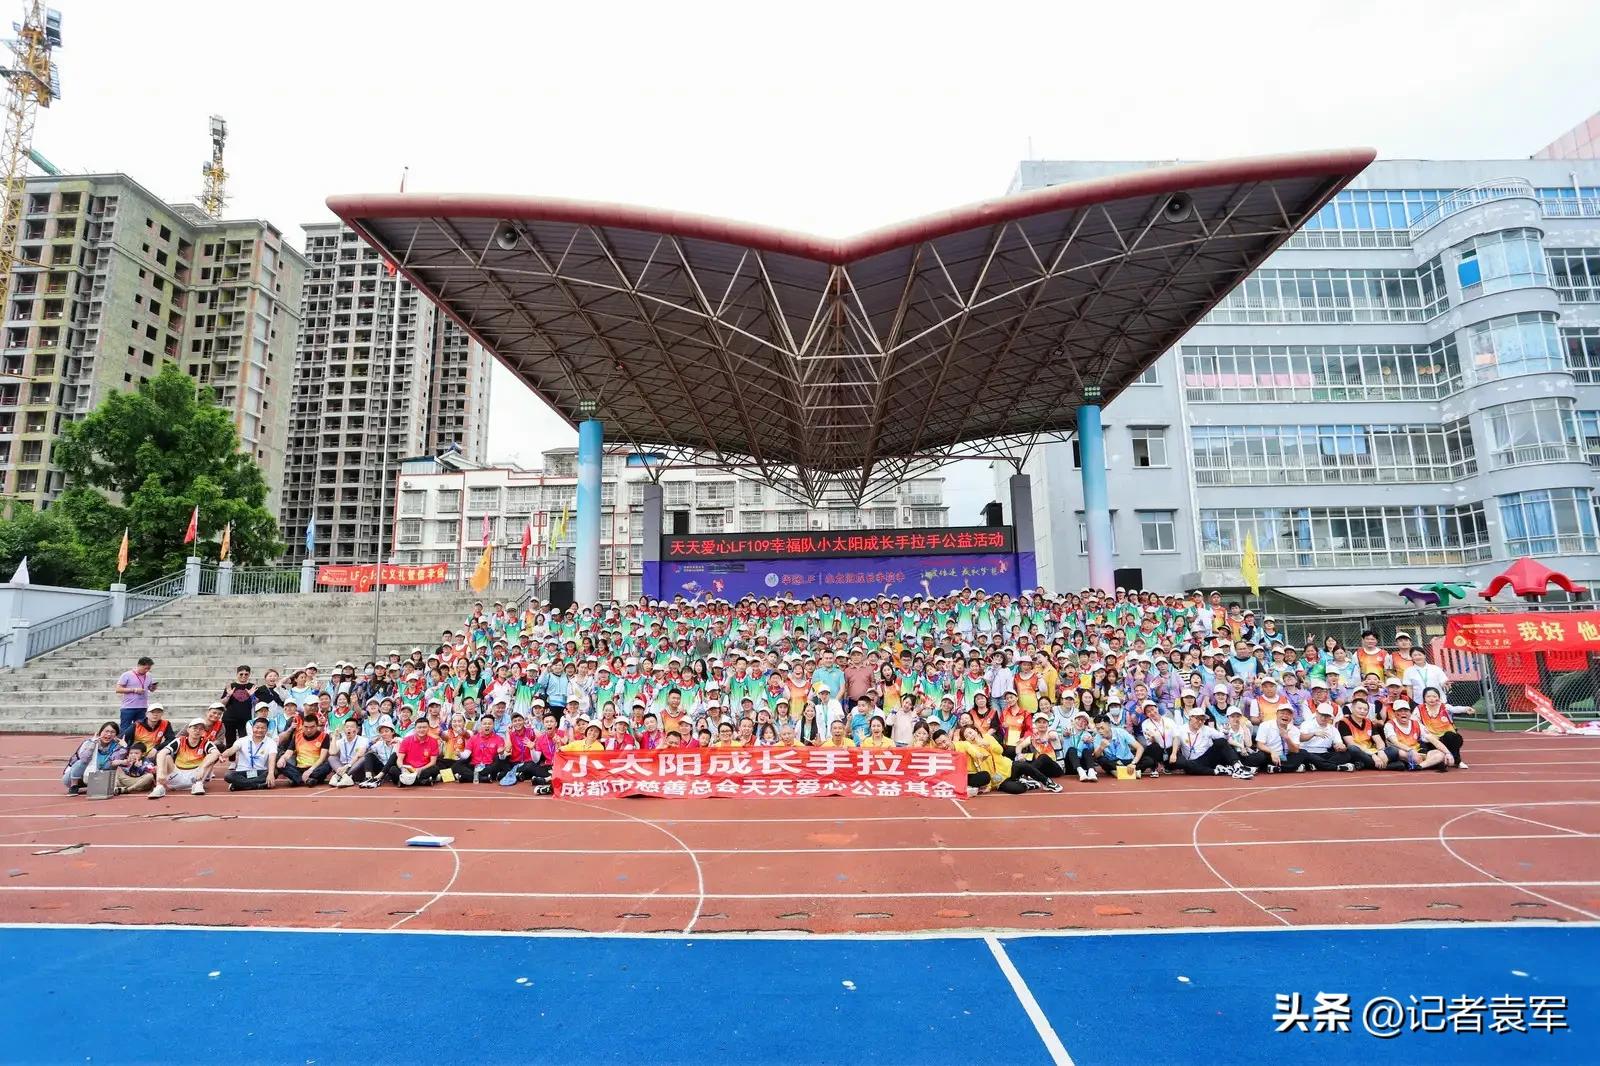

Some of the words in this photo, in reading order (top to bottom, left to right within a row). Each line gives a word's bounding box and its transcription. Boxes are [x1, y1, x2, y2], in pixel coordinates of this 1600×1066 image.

[670, 530, 1004, 555] 天天爱心LF109幸福队小太阳成长手拉手公益活动
[1517, 620, 1565, 642] 我好
[562, 750, 957, 778] 小太阳成长手拉手
